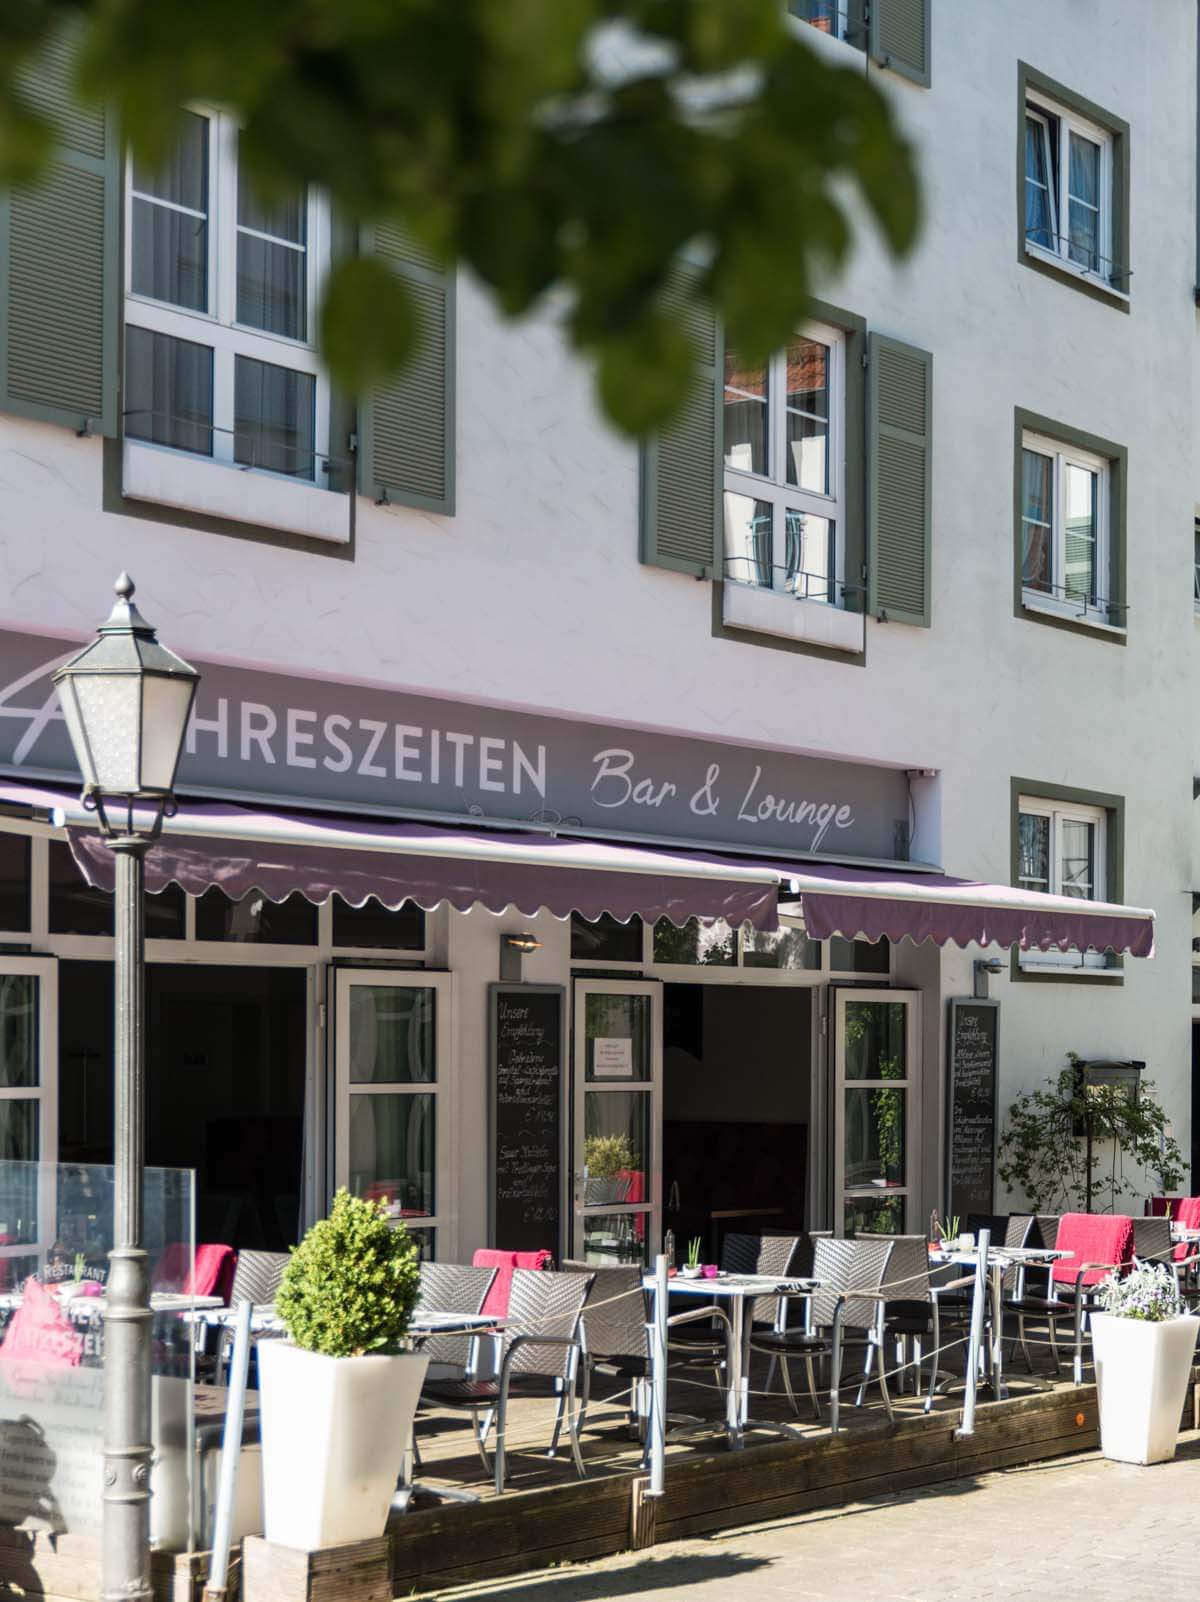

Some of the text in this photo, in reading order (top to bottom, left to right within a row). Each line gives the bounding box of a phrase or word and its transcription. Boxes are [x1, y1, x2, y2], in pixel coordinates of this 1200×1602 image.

[186, 697, 546, 798] HRESZEITEN
[590, 748, 677, 808] Bar
[689, 763, 720, 816] &
[738, 766, 855, 855] Lounge
